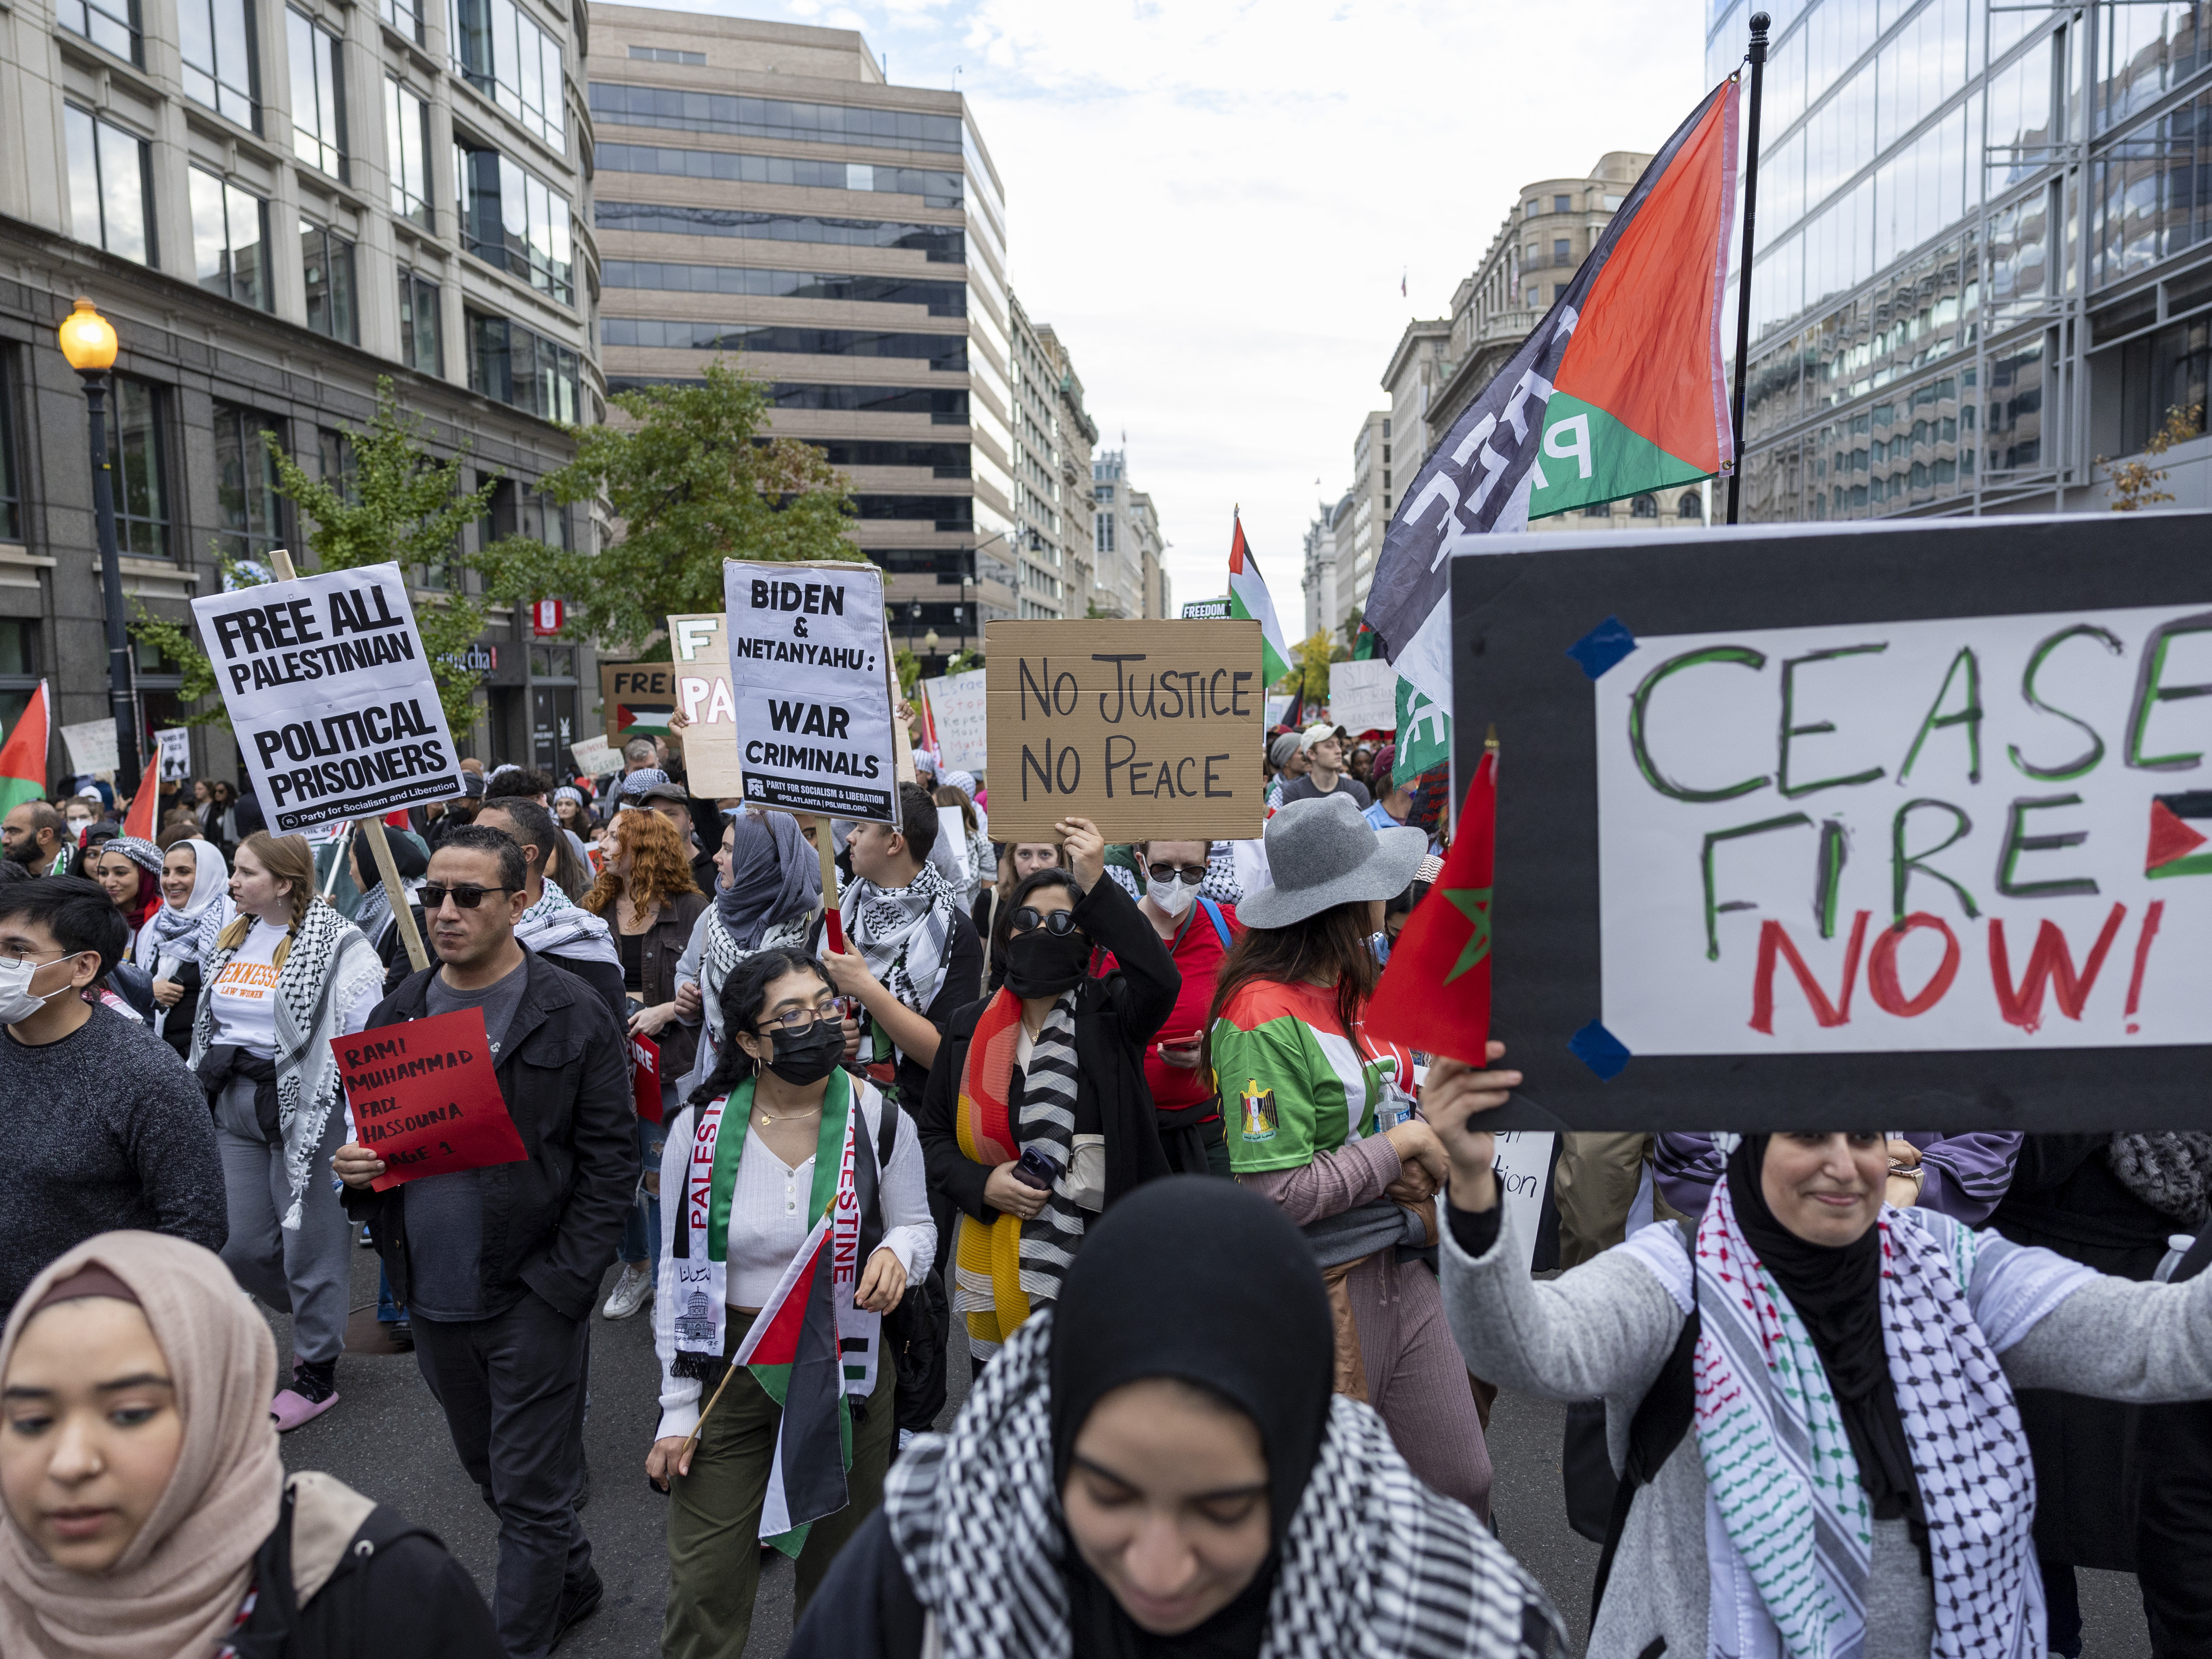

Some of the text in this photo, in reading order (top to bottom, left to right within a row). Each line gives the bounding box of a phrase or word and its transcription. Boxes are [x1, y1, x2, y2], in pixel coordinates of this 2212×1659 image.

[751, 579, 844, 616] BIDEN
[1183, 603, 1225, 618] FREEDOM
[212, 585, 404, 659] FREE ALL
[793, 617, 809, 638] &
[228, 632, 415, 695] PALESTINIAN
[737, 637, 875, 672] NETANYAHU:
[937, 680, 983, 697] Israe
[1019, 653, 1253, 724] NO JUSTICE
[1628, 611, 2212, 803] CEASE
[253, 699, 437, 770] POLITICAL
[768, 699, 850, 739] WAR
[268, 740, 447, 807] PRISONERS
[745, 740, 879, 780] CRIMINALS
[1021, 734, 1233, 802] NO PEACE
[300, 811, 326, 823] Party
[328, 806, 342, 814] for
[343, 798, 388, 812] Socialism
[389, 791, 407, 802] and
[409, 782, 455, 796] Liberation
[747, 782, 766, 798] PSL
[766, 780, 884, 805] PARTY FOR SOCIALISM & LIBERATION
[777, 794, 821, 806] @PSLATLANTA
[825, 801, 867, 812] PSLWEB.ORG
[1700, 793, 2101, 962] FIRE
[1746, 899, 2165, 1035] NOW!
[220, 986, 264, 998] LAW WOMEN
[344, 1037, 406, 1069] RAMI
[346, 1050, 474, 1093] MUHAMMAD
[359, 1096, 401, 1119] FADL
[362, 1102, 464, 1144] HASSOUNA
[389, 1141, 456, 1166] AGE 1
[833, 1108, 858, 1284] ALESTINE
[1492, 1154, 1537, 1198] tion
